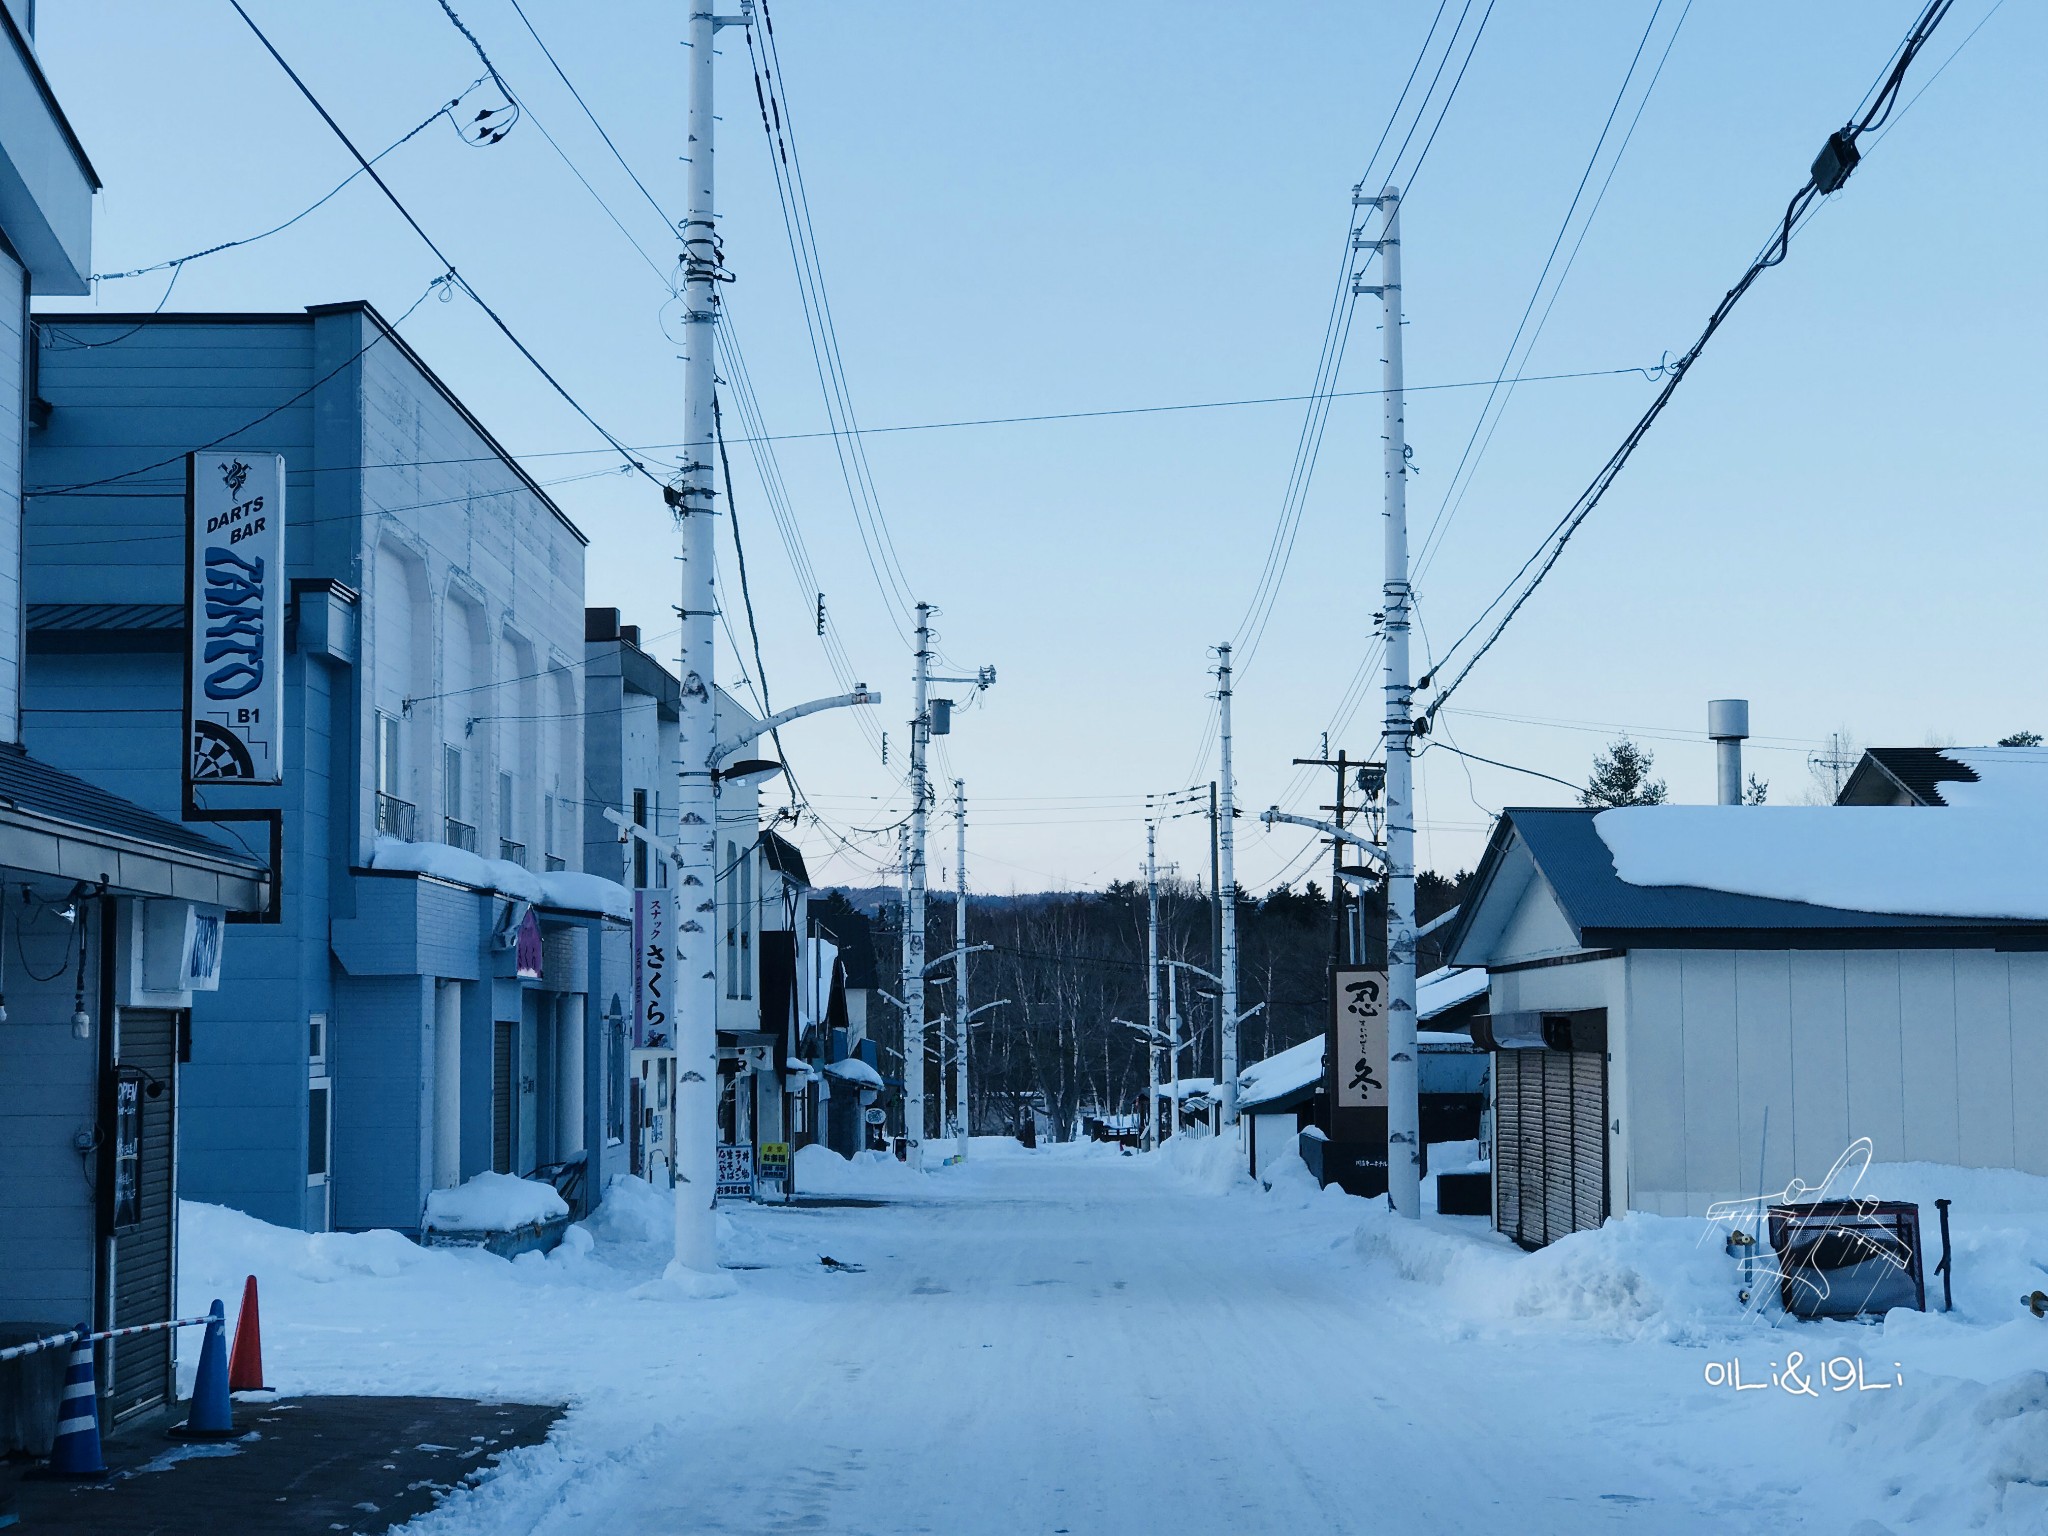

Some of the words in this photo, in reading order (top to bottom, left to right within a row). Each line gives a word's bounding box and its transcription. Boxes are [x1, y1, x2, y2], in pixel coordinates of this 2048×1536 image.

[206, 496, 265, 534] DARTS
[230, 517, 266, 545] BAR
[237, 708, 260, 724] B1
[650, 900, 662, 940] スナック
[646, 944, 665, 1026] さくら
[1345, 980, 1383, 1017] 忍
[117, 1081, 138, 1101] OPEN
[1348, 1058, 1383, 1100] 冬
[726, 1148, 735, 1181] 生そば
[734, 1150, 742, 1181] ラーメン
